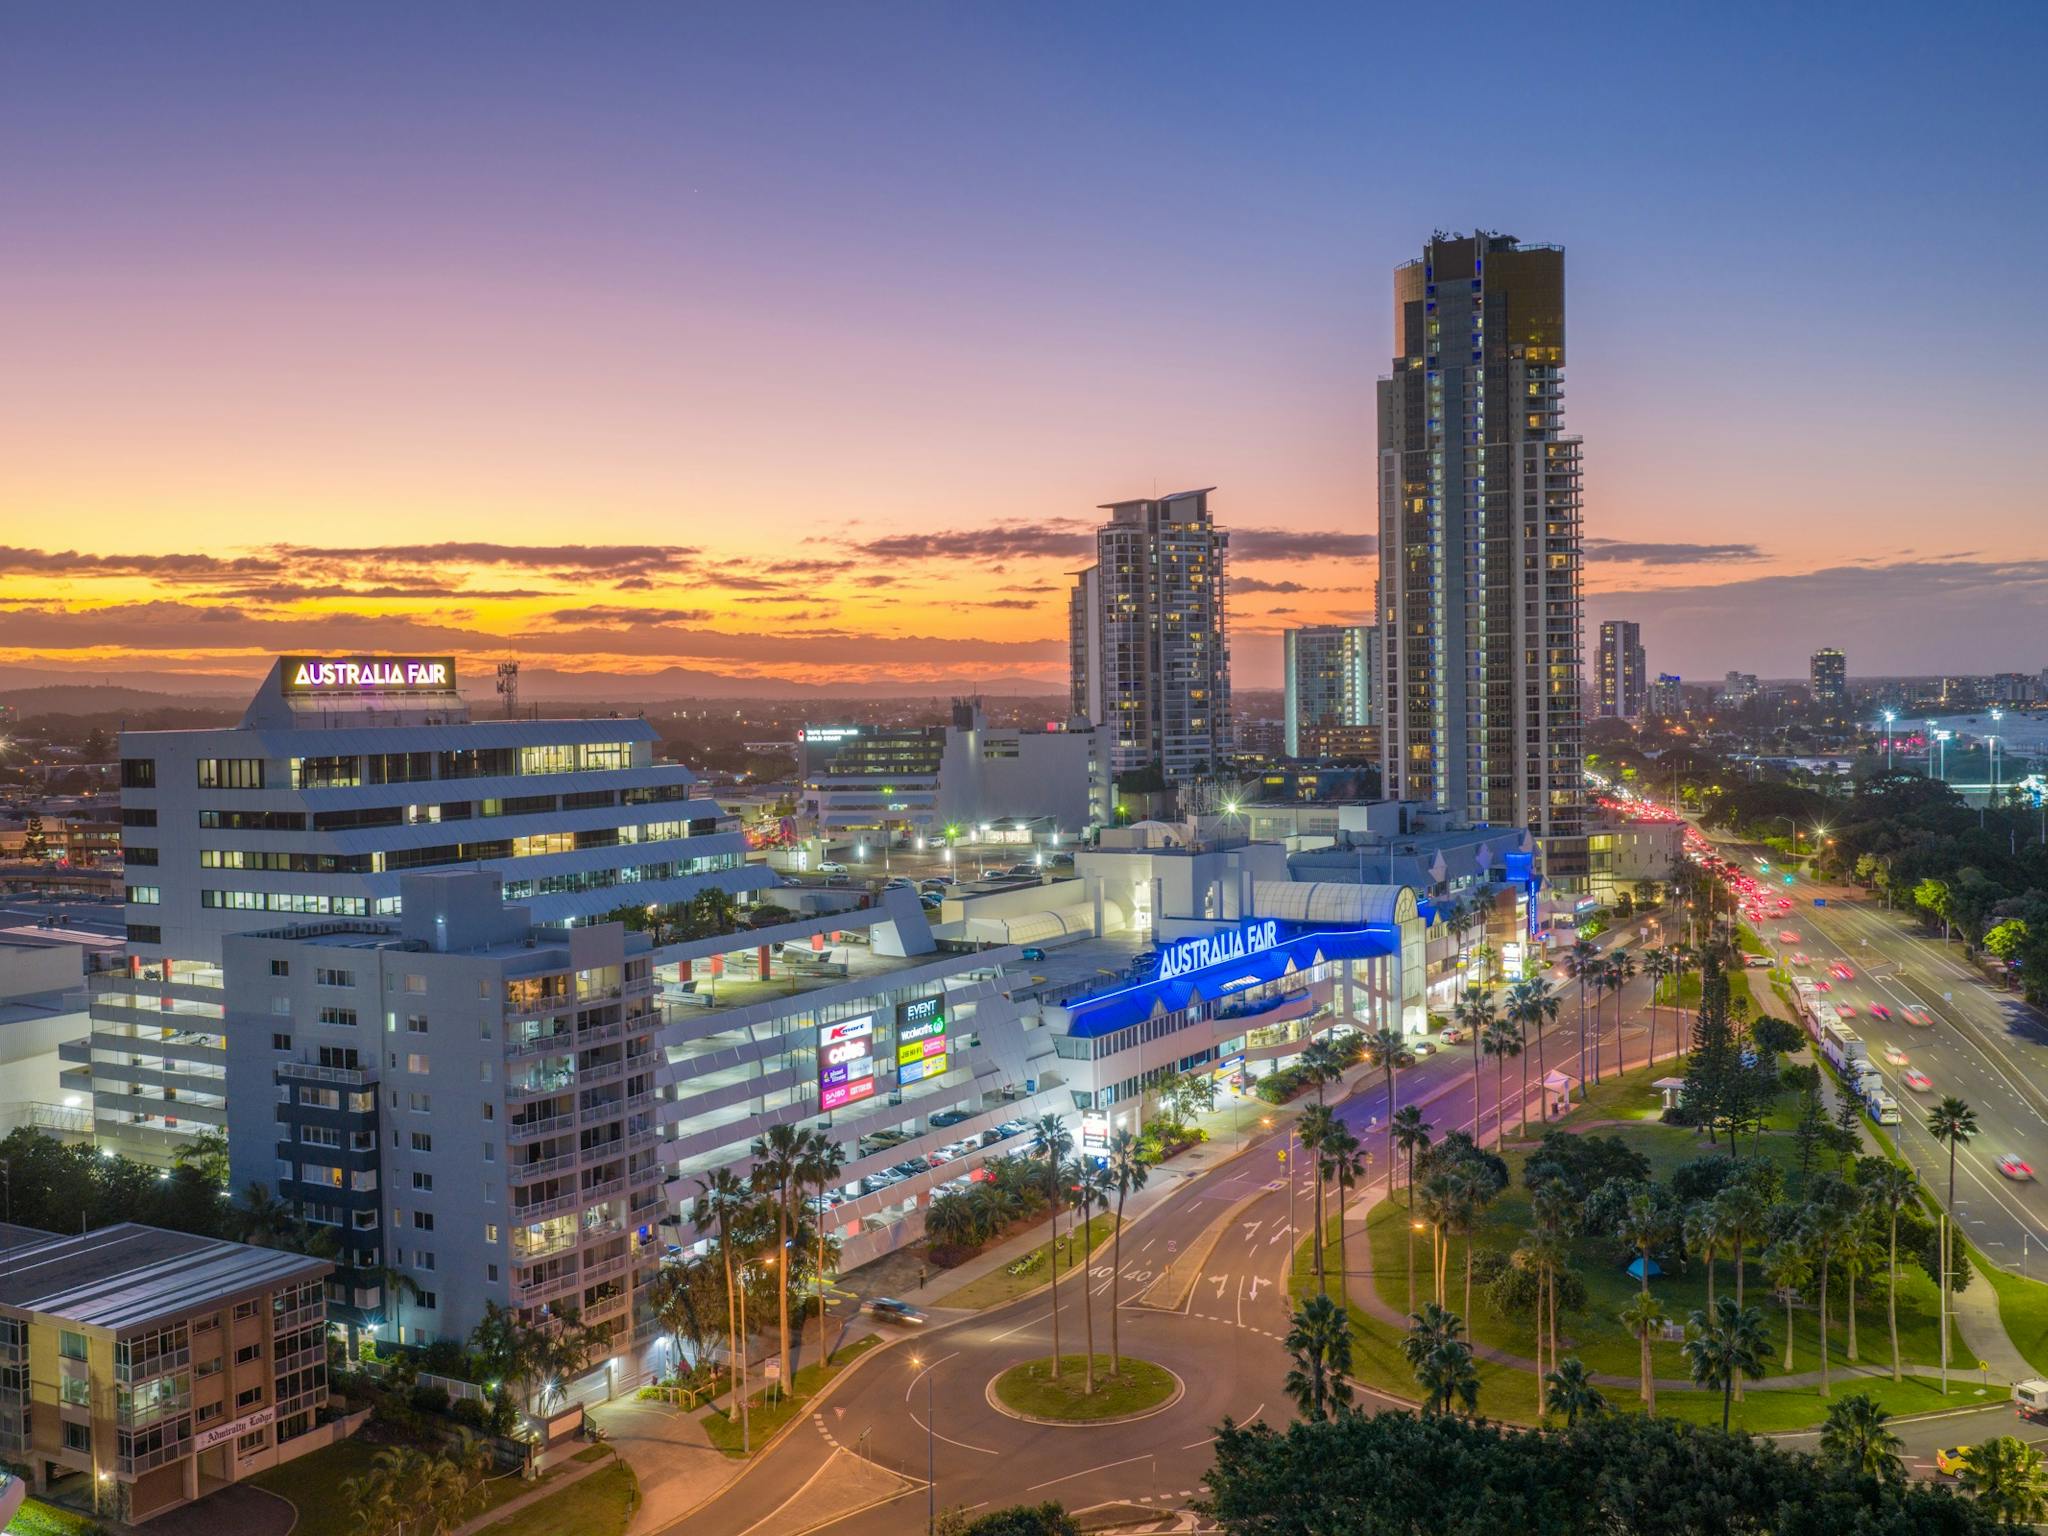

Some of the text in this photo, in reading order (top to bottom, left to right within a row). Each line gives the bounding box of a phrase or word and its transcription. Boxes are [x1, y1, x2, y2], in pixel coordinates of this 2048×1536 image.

[294, 663, 446, 685] AUSTRALIA FAIR
[1159, 920, 1277, 980] AUSTRALIA FAIR
[908, 1000, 936, 1016] EVENT
[830, 1023, 865, 1040] Kmart
[829, 1041, 865, 1064] coles
[825, 1089, 846, 1101] DAISO
[1088, 1265, 1114, 1278] 40
[1123, 1270, 1152, 1282] 40
[208, 1413, 272, 1442] Admiralty Lodge
